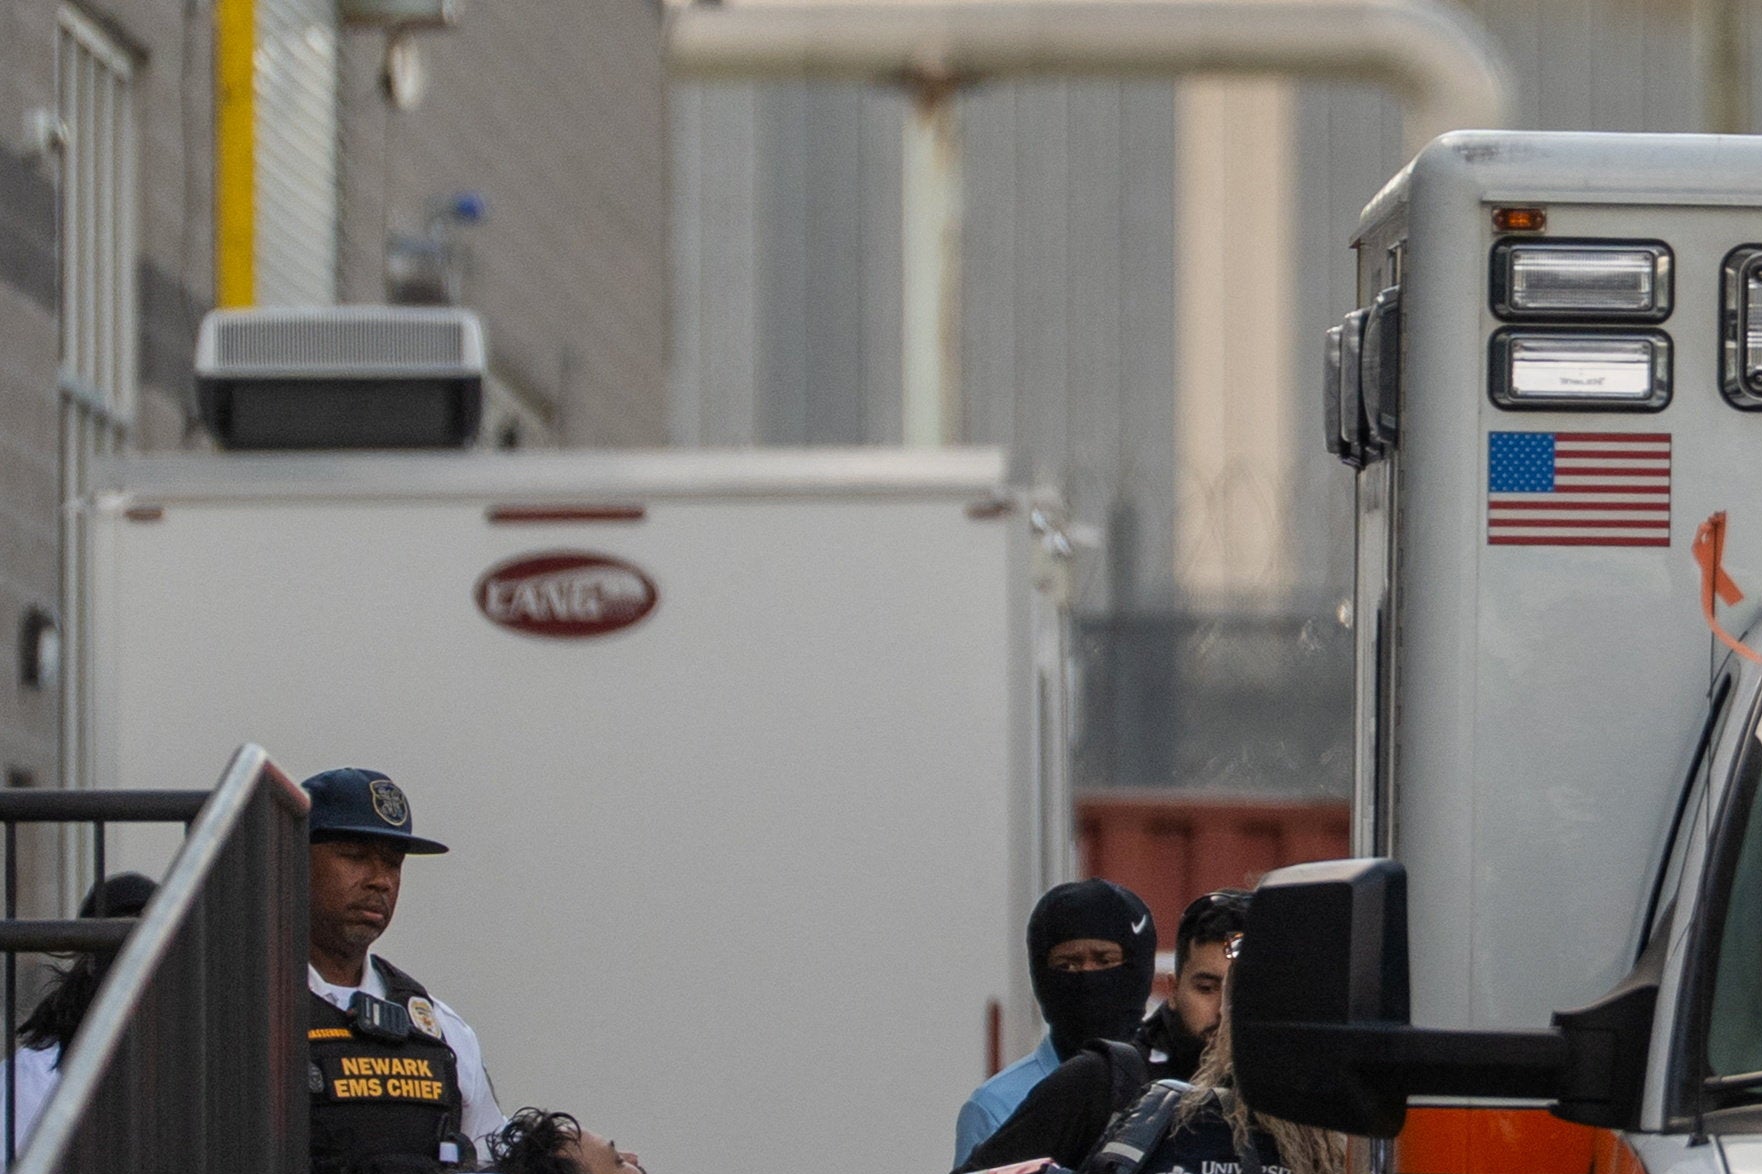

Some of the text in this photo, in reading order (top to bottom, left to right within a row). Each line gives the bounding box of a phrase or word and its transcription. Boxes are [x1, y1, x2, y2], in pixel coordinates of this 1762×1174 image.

[341, 1057, 433, 1077] NEWARK
[334, 1078, 442, 1099] EMS CHIEF
